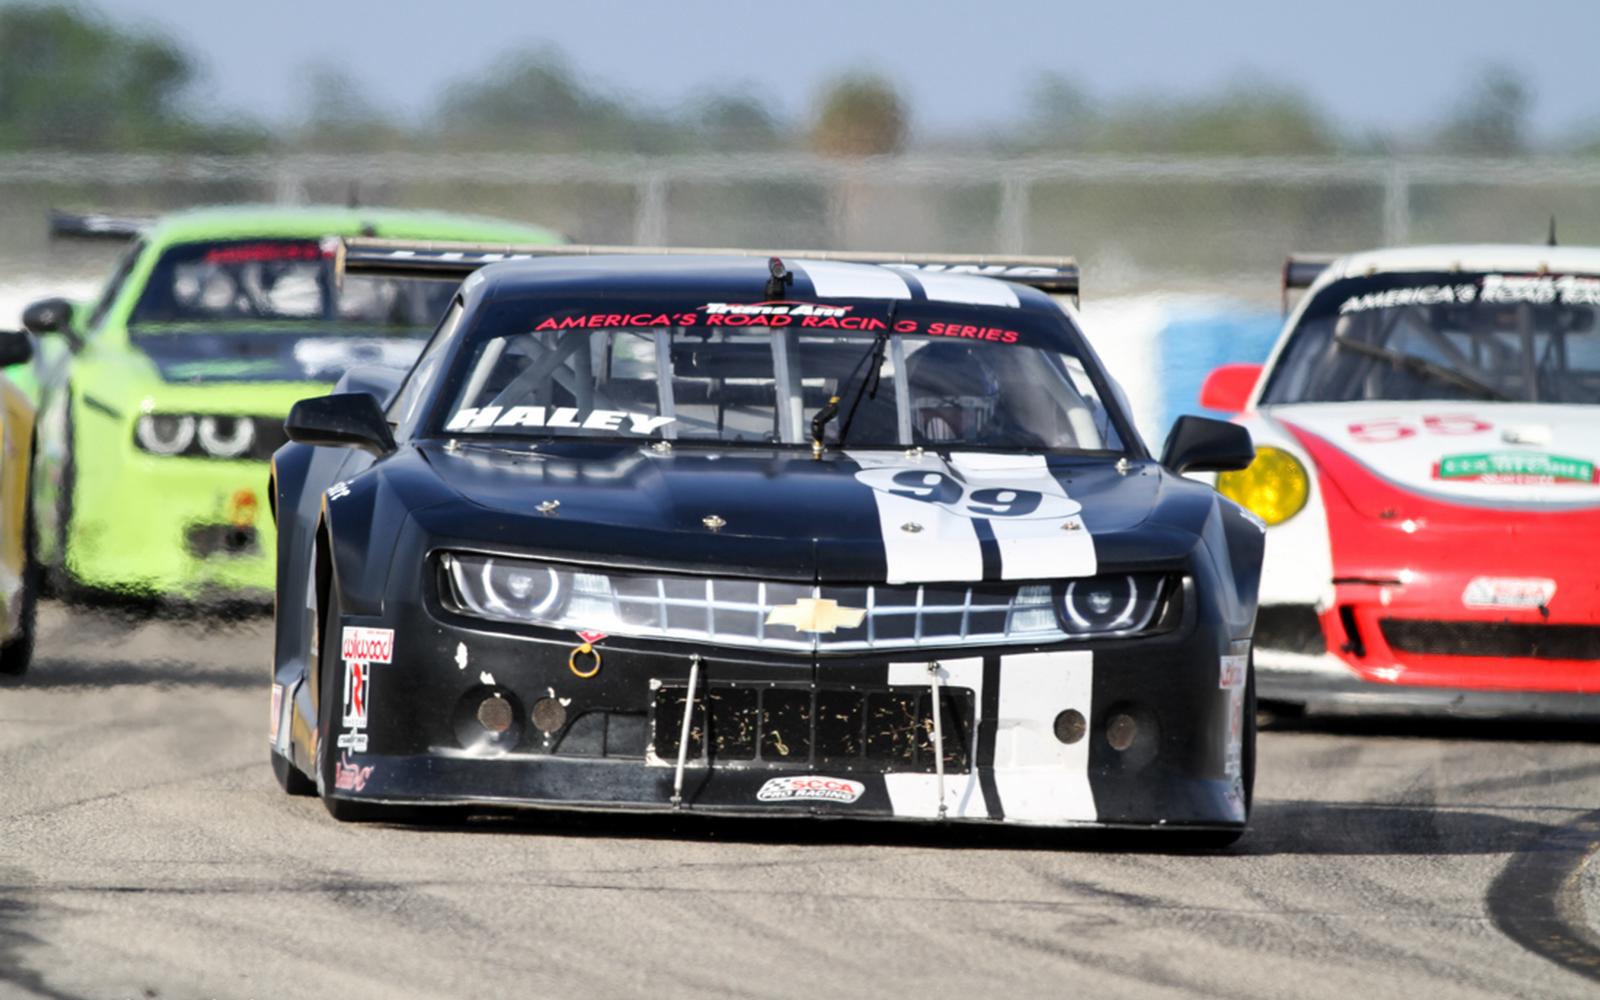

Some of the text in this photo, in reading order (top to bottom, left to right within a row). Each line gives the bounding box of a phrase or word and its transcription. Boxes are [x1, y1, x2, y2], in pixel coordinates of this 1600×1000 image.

[535, 313, 1019, 343] AMERICA'S ROAD RACING SERIES
[446, 406, 676, 434] HALEY
[1346, 414, 1493, 443] 55
[888, 470, 1043, 517] 99
[791, 780, 855, 793] SCCA
[795, 790, 855, 800] RACING
